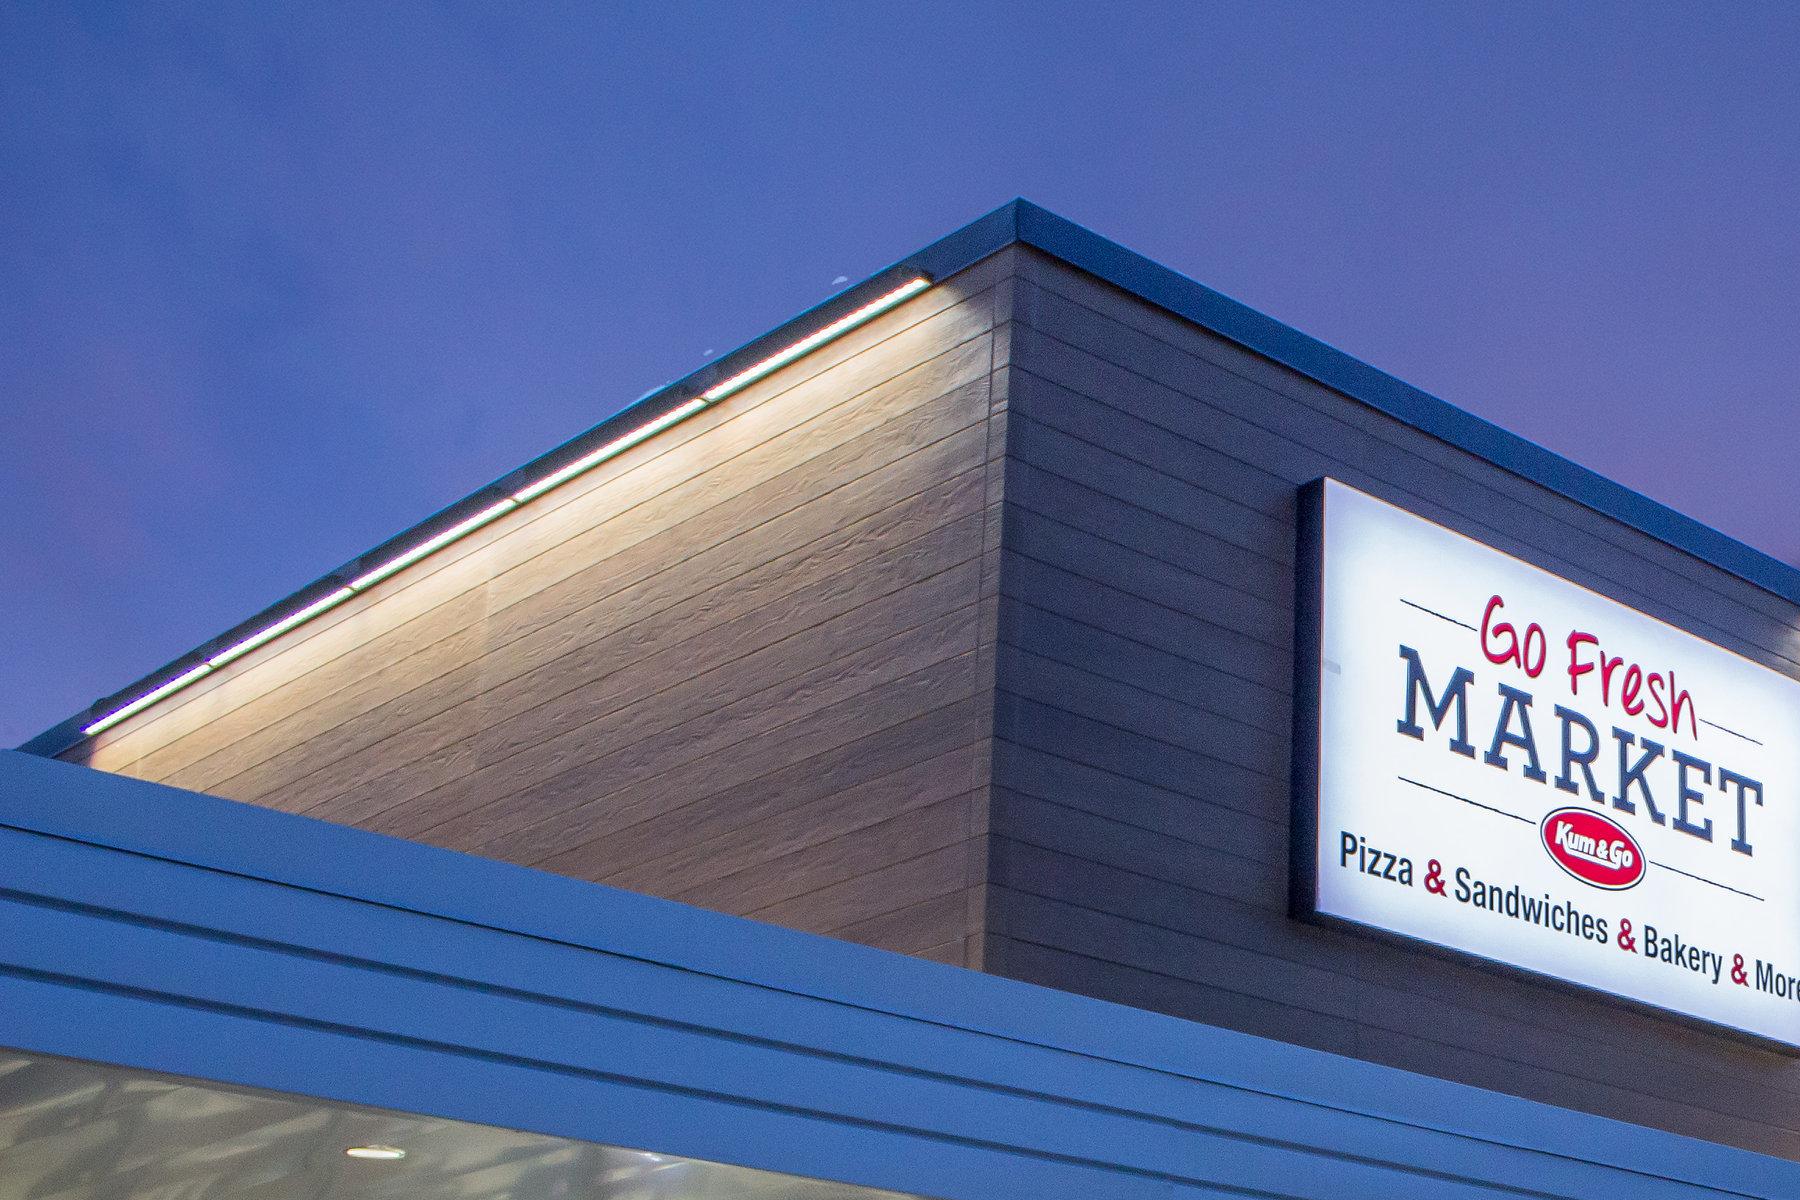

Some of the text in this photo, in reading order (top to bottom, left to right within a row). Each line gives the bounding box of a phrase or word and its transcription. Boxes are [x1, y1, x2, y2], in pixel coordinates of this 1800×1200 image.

[1480, 595, 1699, 741] Go Fresh
[1396, 644, 1765, 857] MARKET
[1339, 831, 1414, 887] Pizza
[1423, 858, 1447, 897] &
[1454, 867, 1609, 945] Sandwiches
[1617, 917, 1638, 954] &
[1644, 925, 1724, 985] Bakery
[1730, 953, 1750, 988] &
